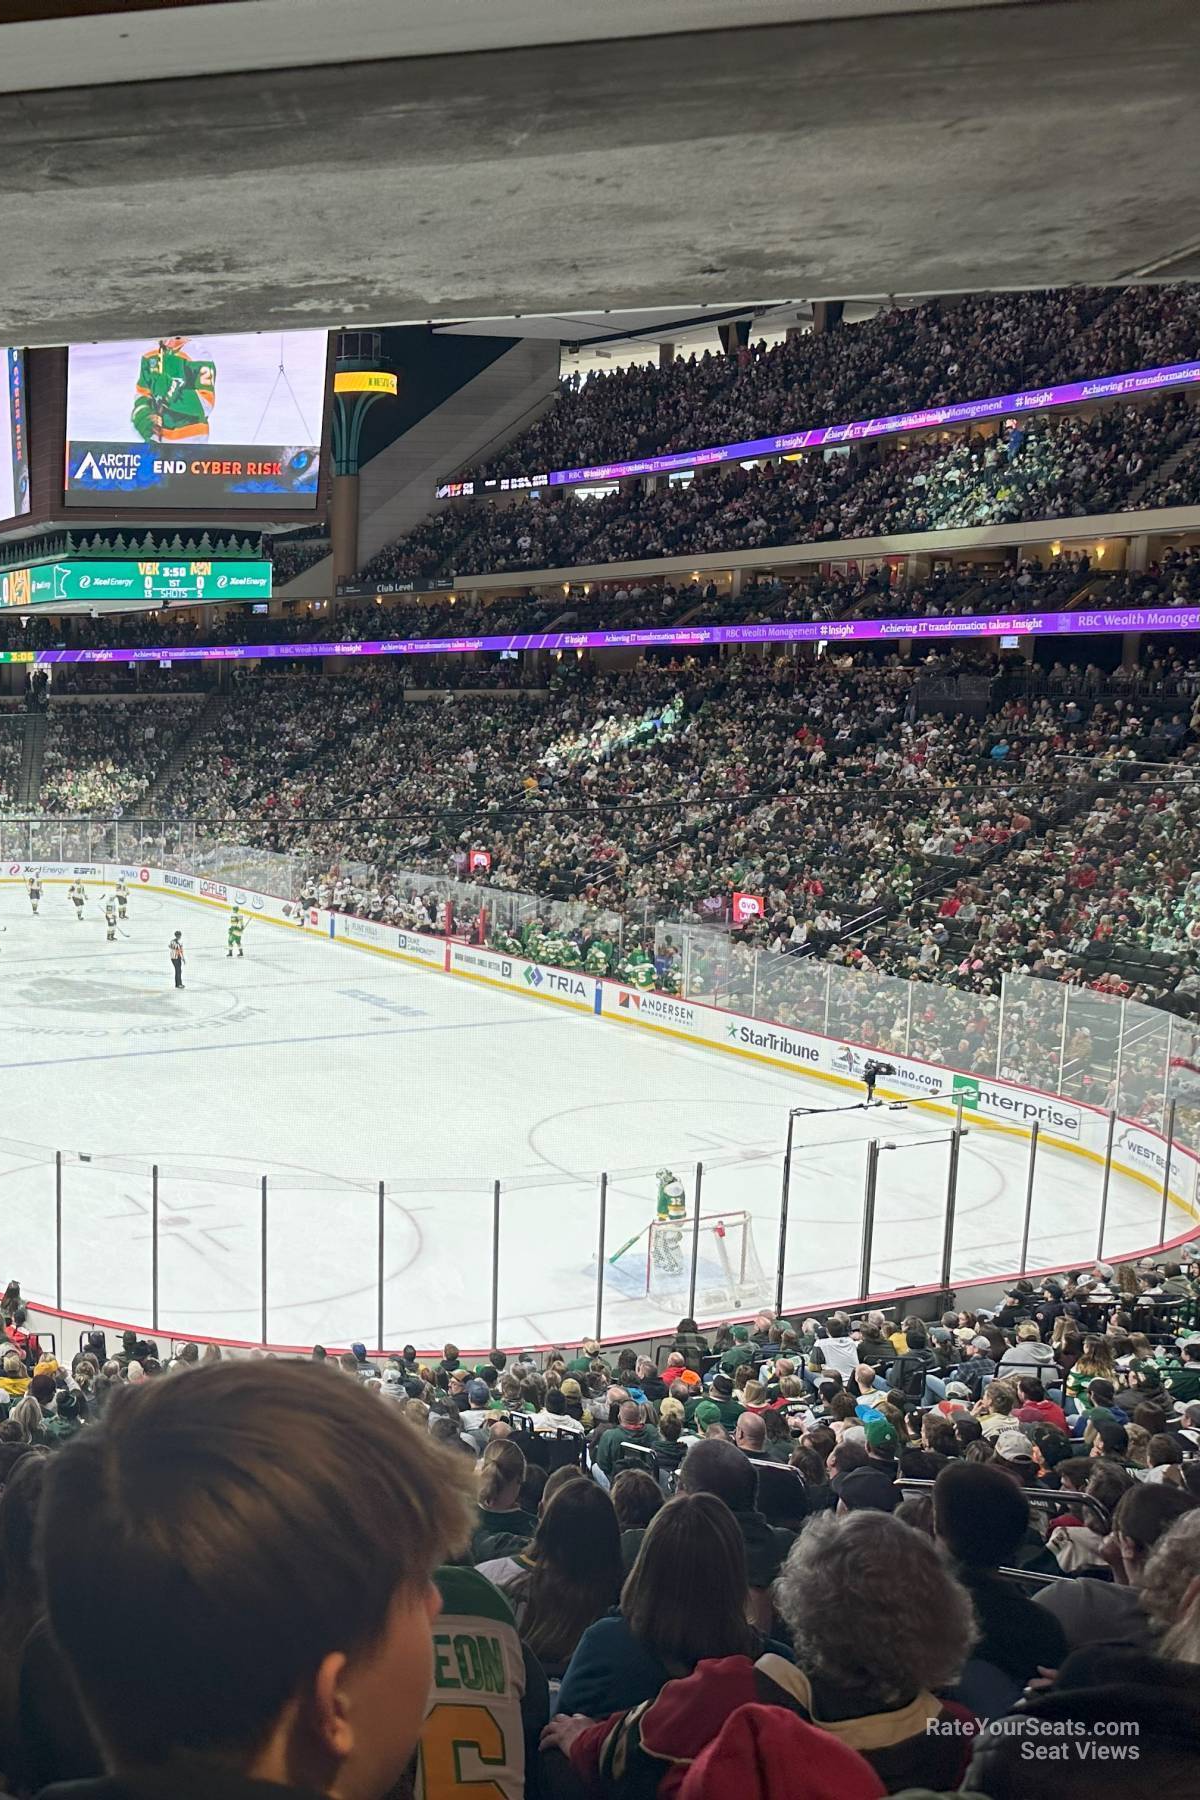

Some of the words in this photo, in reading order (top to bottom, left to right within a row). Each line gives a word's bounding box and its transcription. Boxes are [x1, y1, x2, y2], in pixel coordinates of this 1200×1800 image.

[1082, 382, 1123, 396] Achieving
[1124, 378, 1134, 388] IT
[1136, 368, 1200, 386] transformation
[100, 454, 141, 466] ARCTIC
[104, 468, 136, 480] WOLF
[154, 461, 186, 474] END
[191, 462, 242, 474] CYBER
[247, 462, 282, 475] RISK
[163, 568, 186, 576] 3:50
[144, 576, 152, 588] 0
[196, 576, 204, 588] 0
[377, 584, 393, 592] Club
[395, 582, 414, 592] Level
[160, 590, 188, 598] SHOTS
[197, 590, 202, 598] 5
[880, 624, 917, 634] Achieving
[918, 622, 928, 632] IT
[928, 620, 986, 632] transformation
[988, 620, 1010, 630] takes
[1012, 618, 1042, 630] Insight
[1078, 616, 1100, 626] RBC
[1104, 614, 1144, 626] Wealth
[605, 634, 630, 644] Achieving
[636, 632, 675, 642] transformation
[676, 632, 690, 640] takes
[691, 631, 710, 641] Insight
[726, 629, 740, 638] RBC
[742, 628, 766, 637] Wealth
[768, 627, 817, 638] Management
[381, 643, 406, 652] Achieving
[414, 642, 451, 650] transformation
[466, 640, 484, 649] Insight
[133, 650, 160, 660] Achieving
[169, 650, 208, 658] transformation
[224, 648, 244, 658] Insight
[164, 874, 178, 886] BUD
[178, 876, 194, 890] LIGHT
[200, 881, 227, 895] LOFFLER
[546, 973, 586, 997] TRIA
[642, 998, 694, 1020] ANDERSEN
[740, 1026, 820, 1062] StarTribune
[434, 1635, 506, 1694] EON
